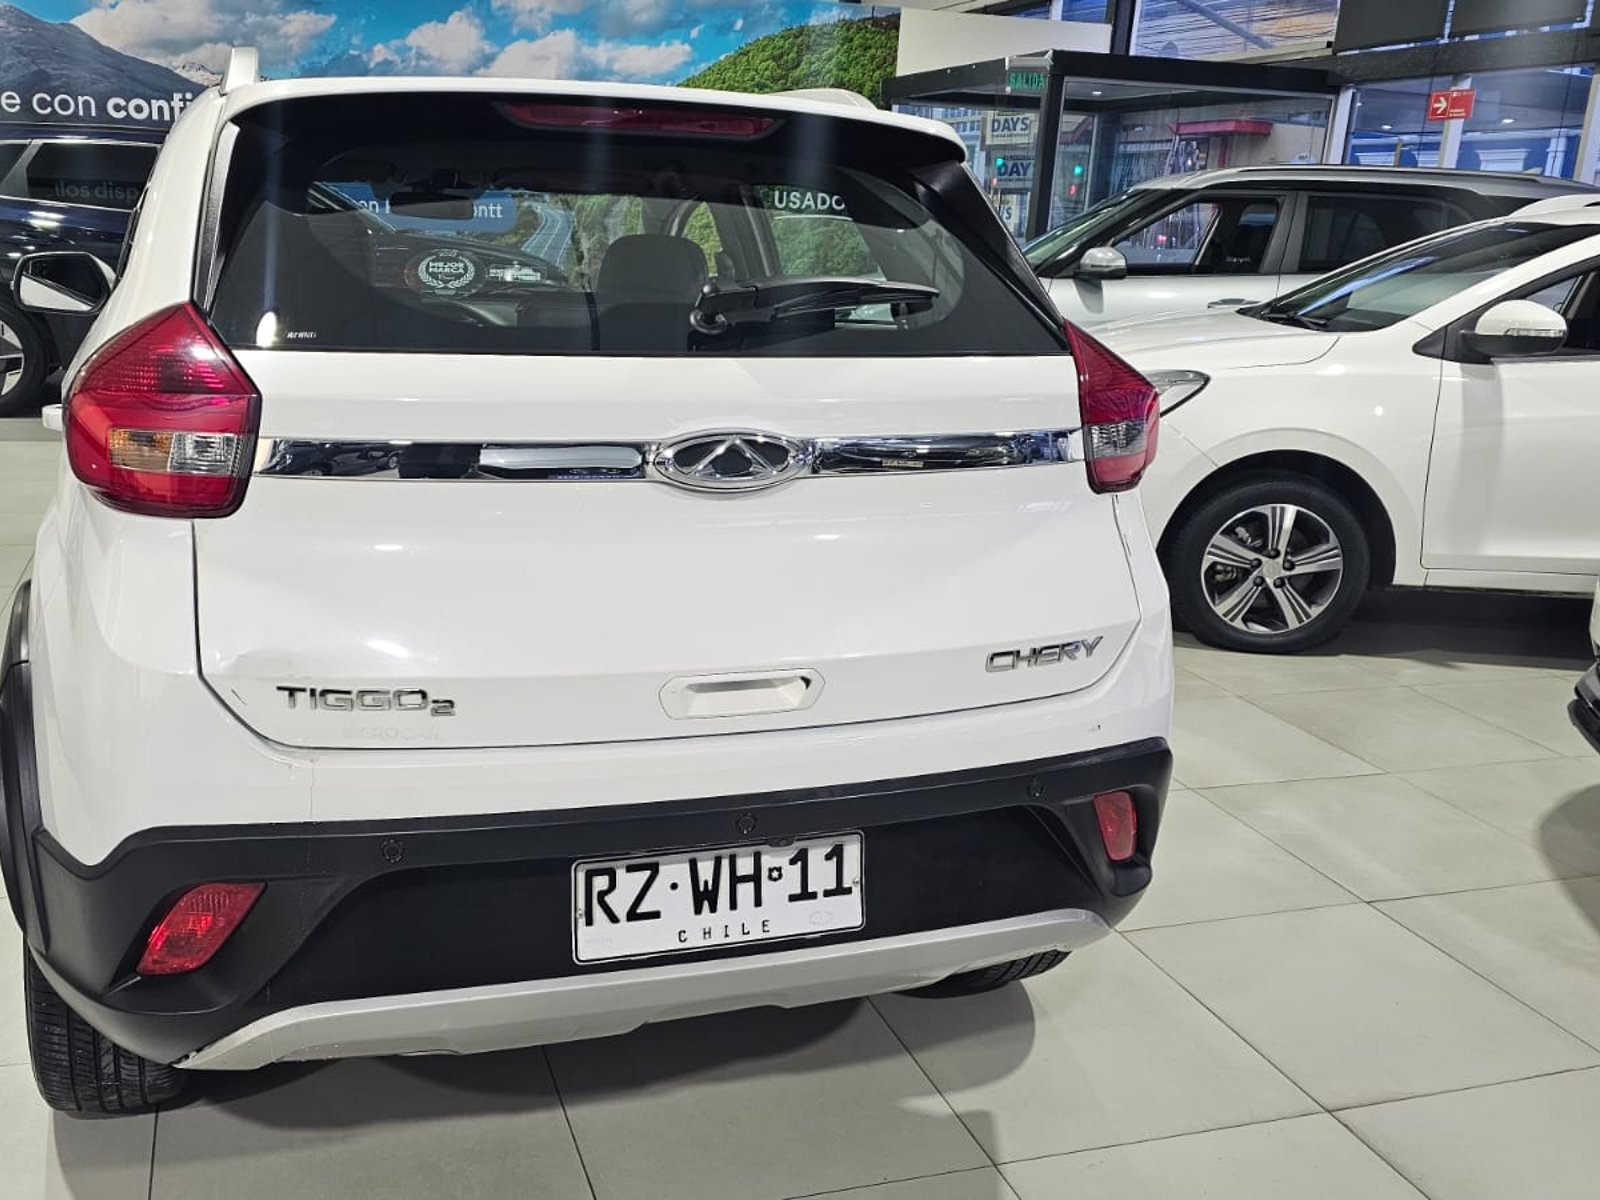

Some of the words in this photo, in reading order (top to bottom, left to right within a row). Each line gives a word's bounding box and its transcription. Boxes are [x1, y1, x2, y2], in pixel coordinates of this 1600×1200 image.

[1009, 71, 1045, 89] SALIDA
[32, 93, 96, 116] con
[992, 116, 1029, 133] DAYS
[985, 635, 1104, 672] CHERY
[678, 919, 771, 943] CHILE
